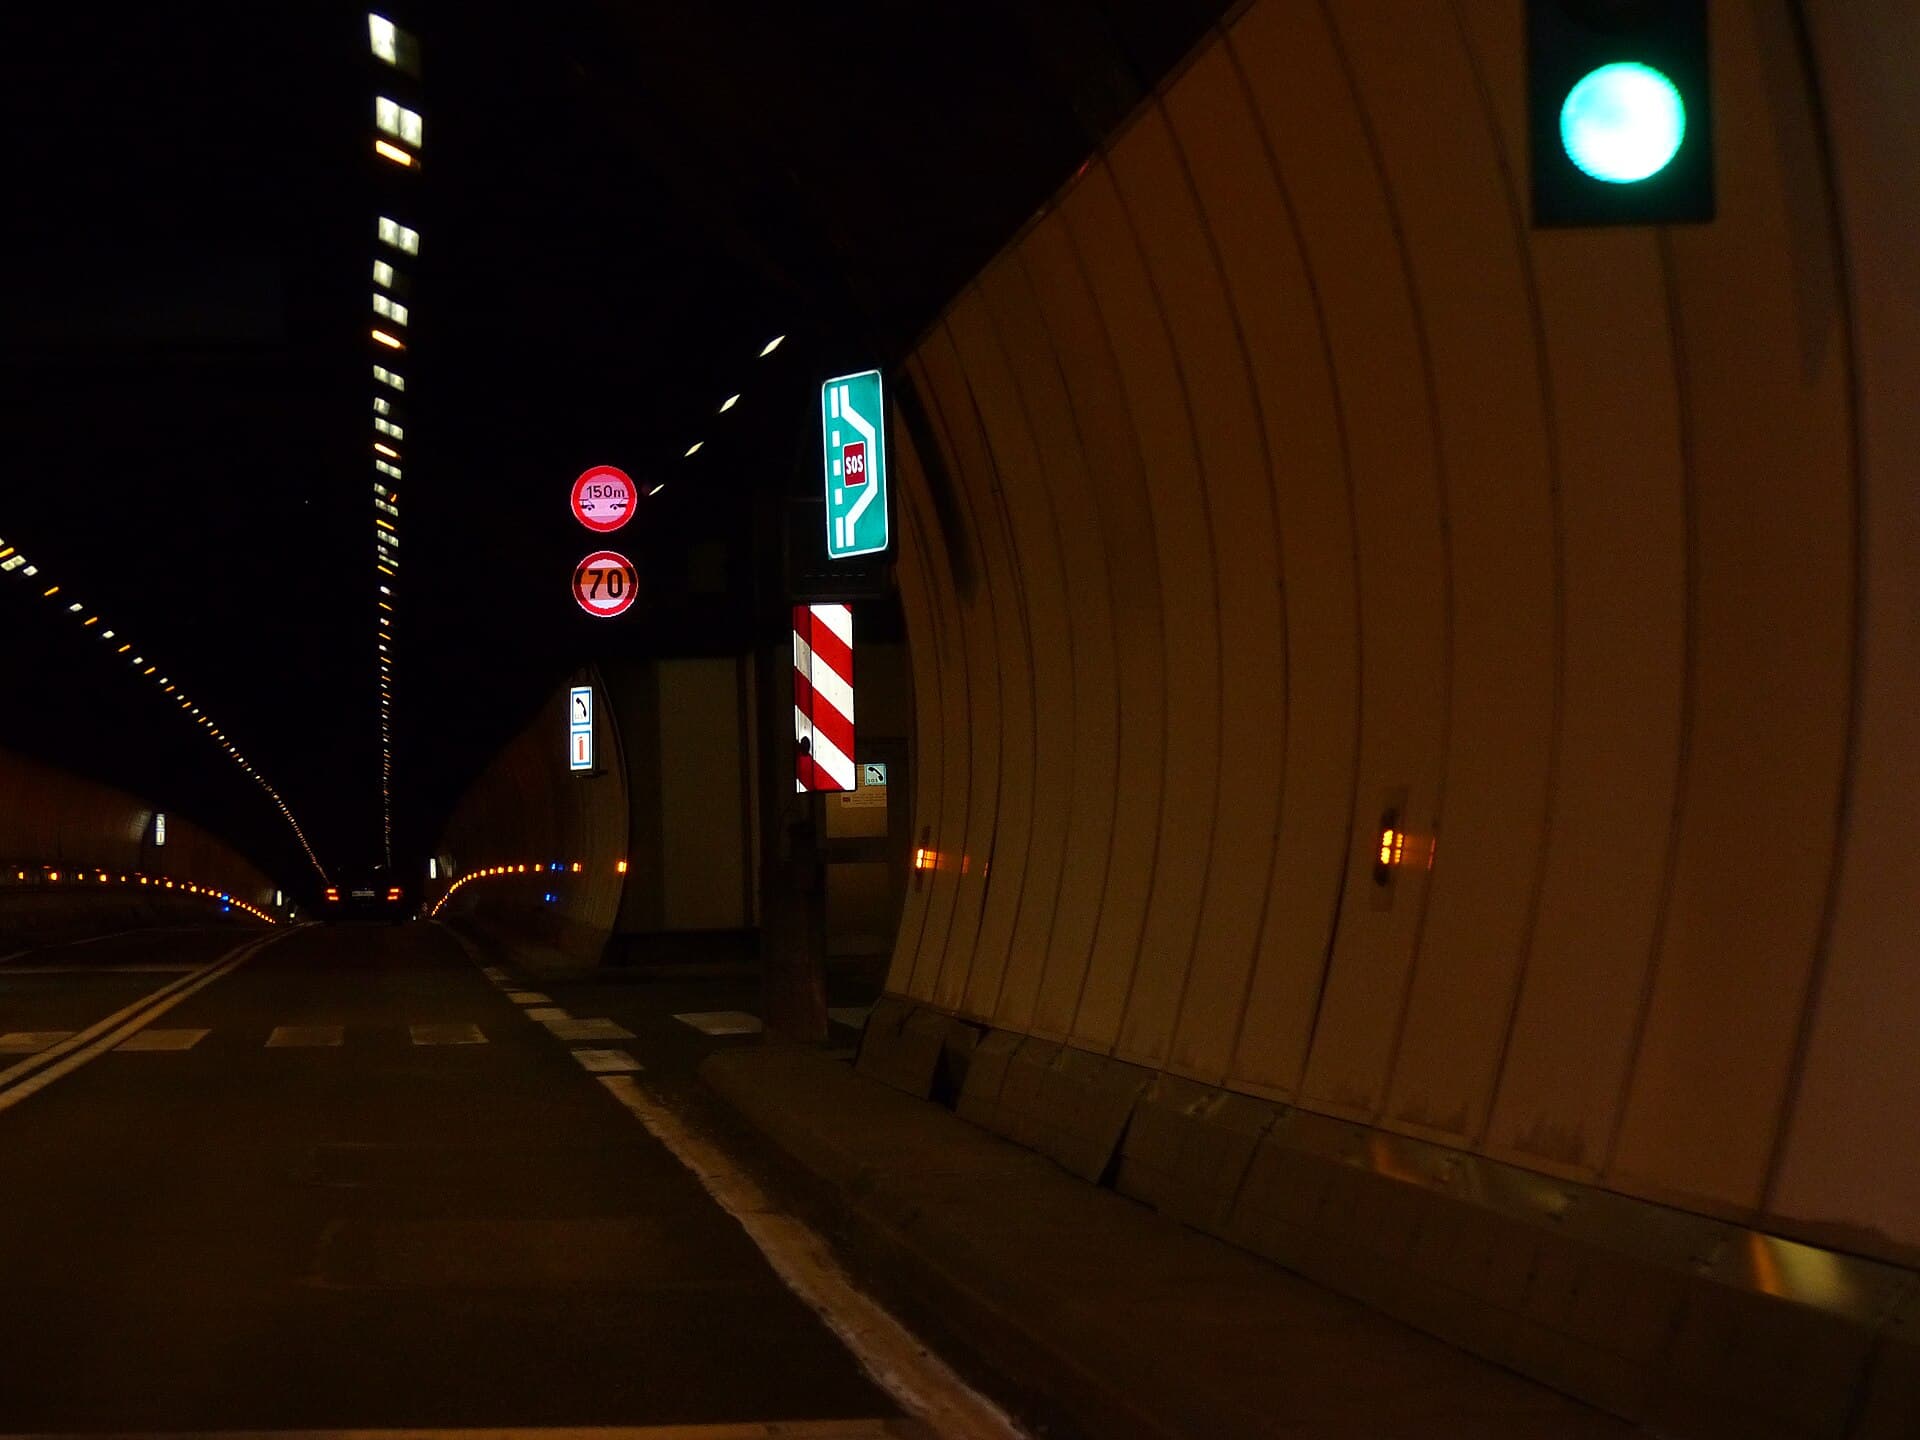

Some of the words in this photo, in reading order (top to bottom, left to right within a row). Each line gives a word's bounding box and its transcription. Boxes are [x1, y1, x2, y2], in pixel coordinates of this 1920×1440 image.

[845, 454, 864, 475] SOS
[587, 485, 625, 499] 150m
[588, 569, 623, 600] 70
